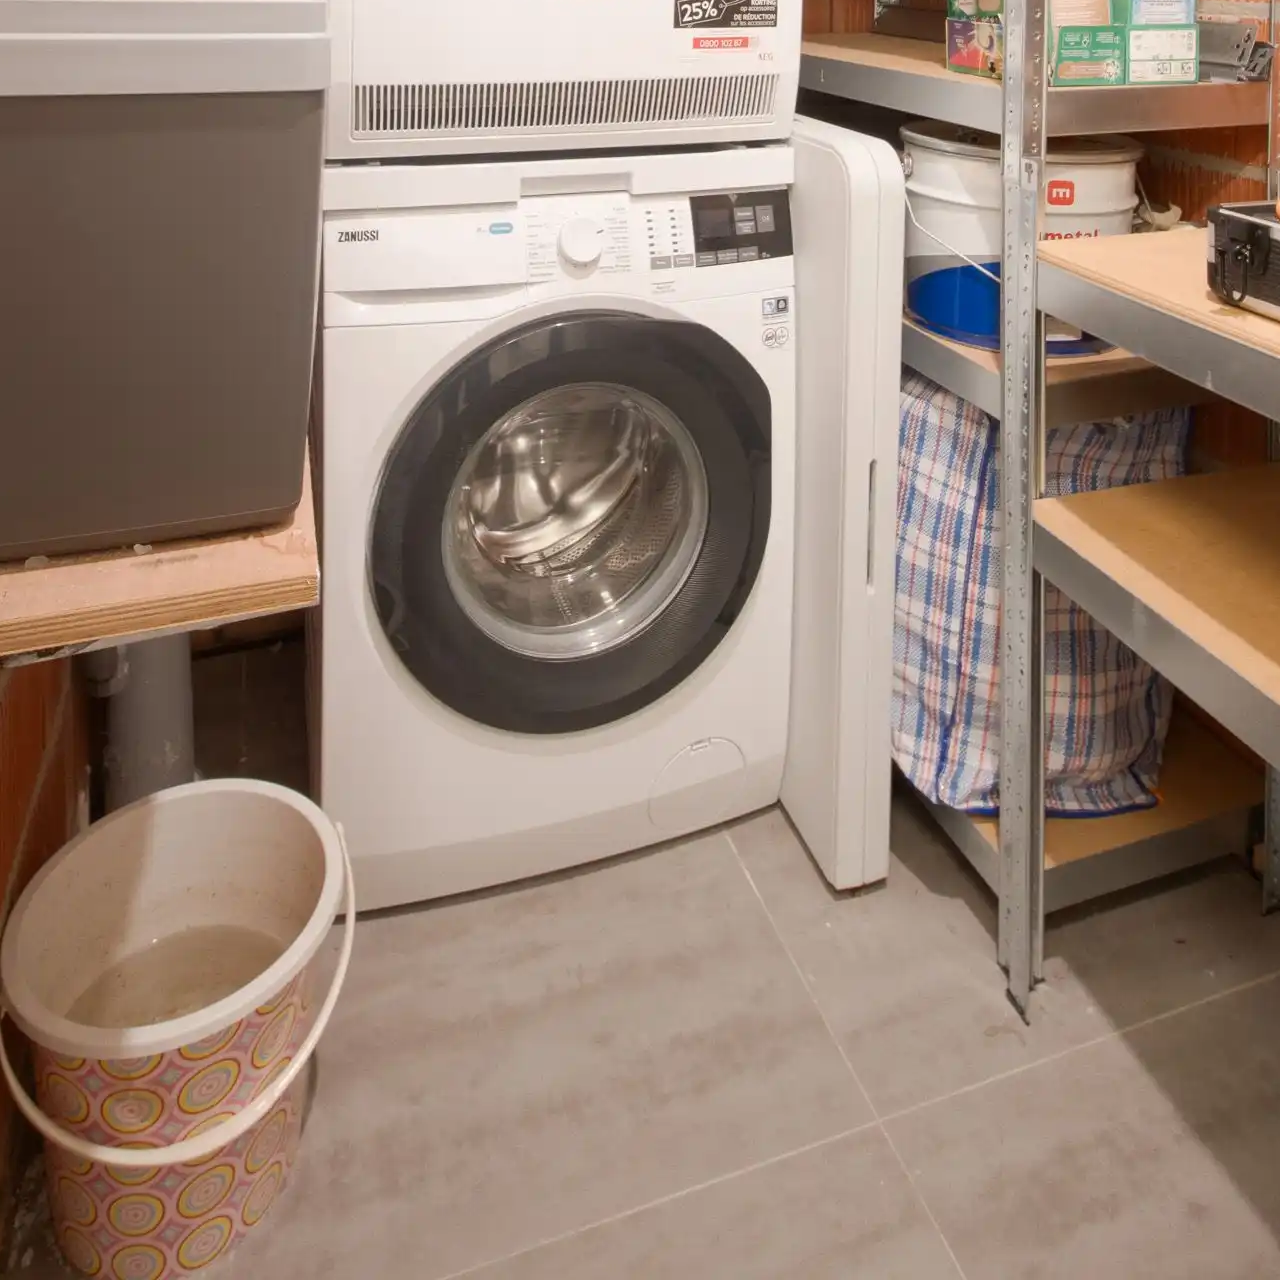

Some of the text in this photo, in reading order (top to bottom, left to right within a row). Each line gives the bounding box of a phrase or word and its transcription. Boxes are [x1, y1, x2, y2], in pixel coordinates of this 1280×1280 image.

[681, 0, 718, 23] 25%
[742, 12, 776, 20] RÉDUCTION
[338, 230, 379, 242] ZANUSSI
